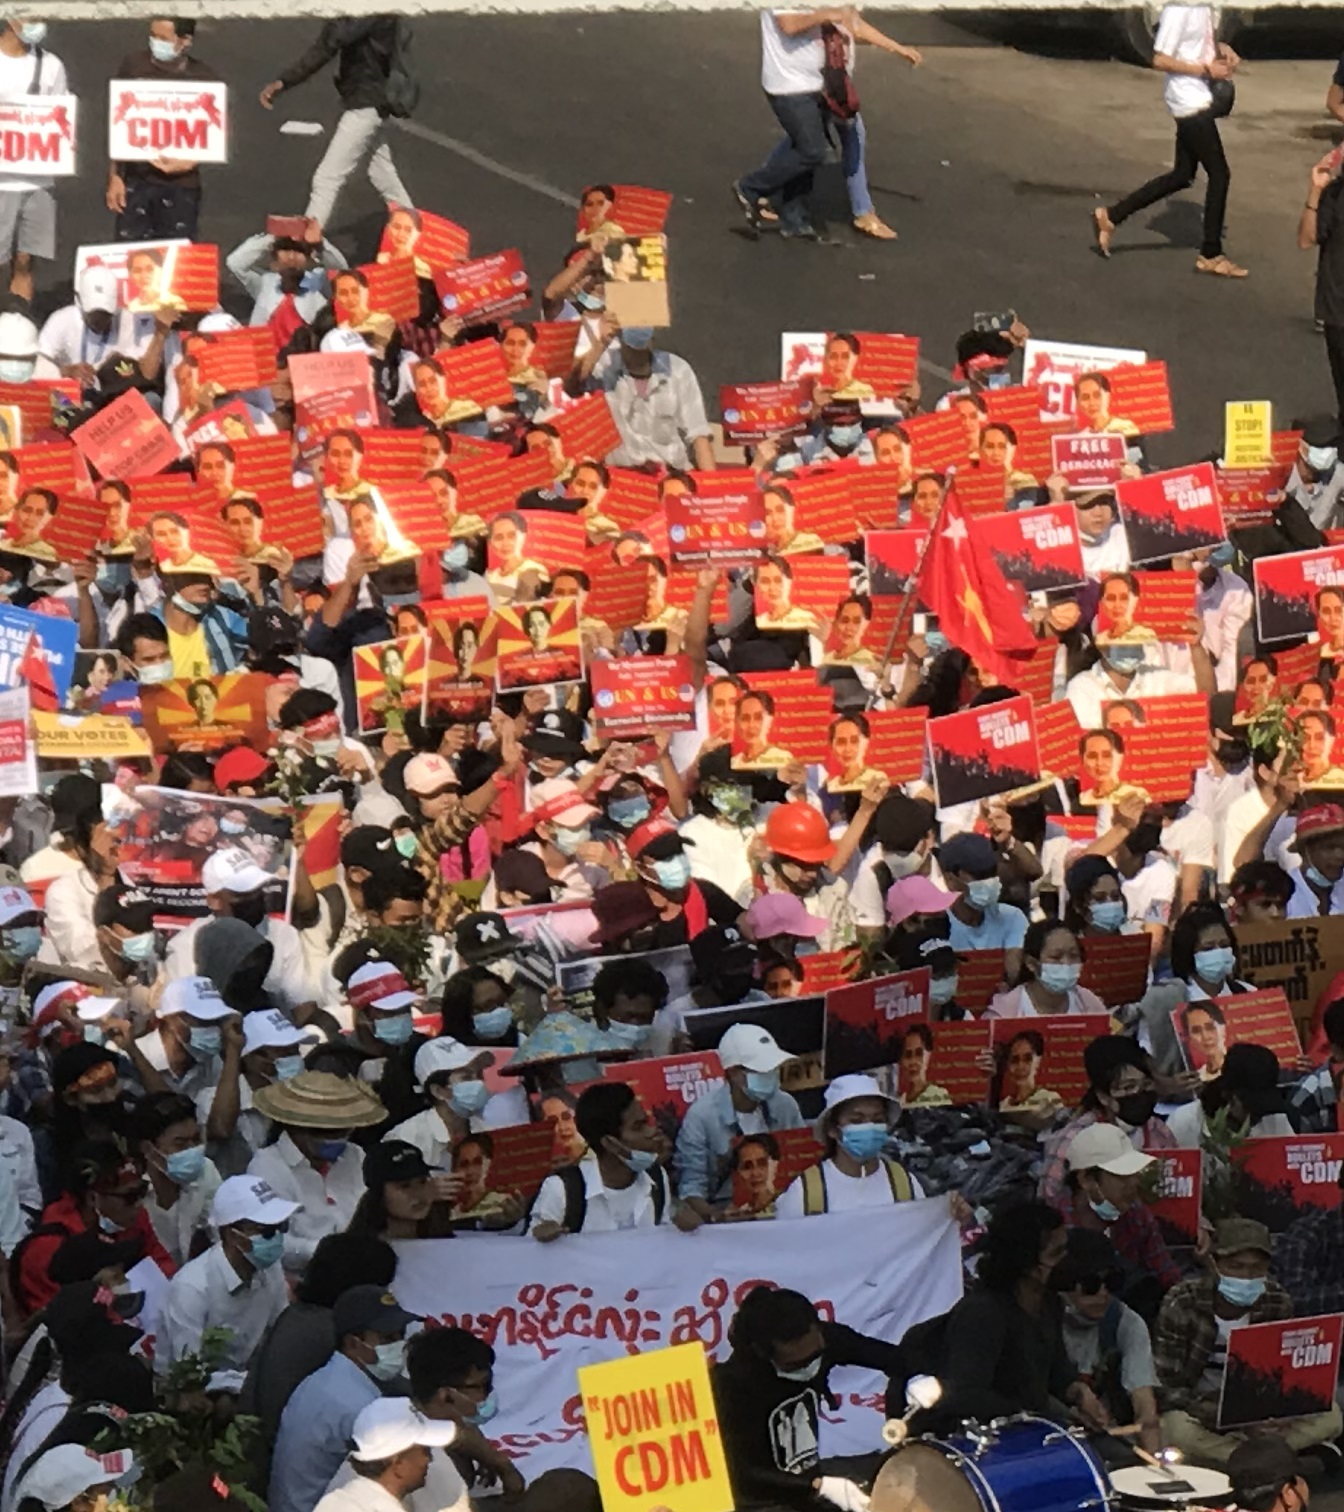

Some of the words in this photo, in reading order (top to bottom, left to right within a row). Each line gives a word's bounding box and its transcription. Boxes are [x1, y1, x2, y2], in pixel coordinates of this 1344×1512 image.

[127, 117, 209, 149] CDM
[0, 129, 61, 163] DM
[1235, 419, 1263, 432] STOP!
[1070, 439, 1110, 455] FREE
[1177, 485, 1213, 511] CDM
[710, 524, 722, 537] &
[1035, 525, 1073, 550] CDM
[614, 691, 636, 703] UN
[643, 689, 655, 701] &
[661, 687, 679, 700] US
[77, 730, 129, 741] VOTES
[992, 721, 1030, 749] CDM
[885, 992, 923, 1020] CDM
[1300, 1160, 1342, 1184] CDM
[1292, 1343, 1333, 1369] CDM
[666, 1379, 697, 1423] IN
